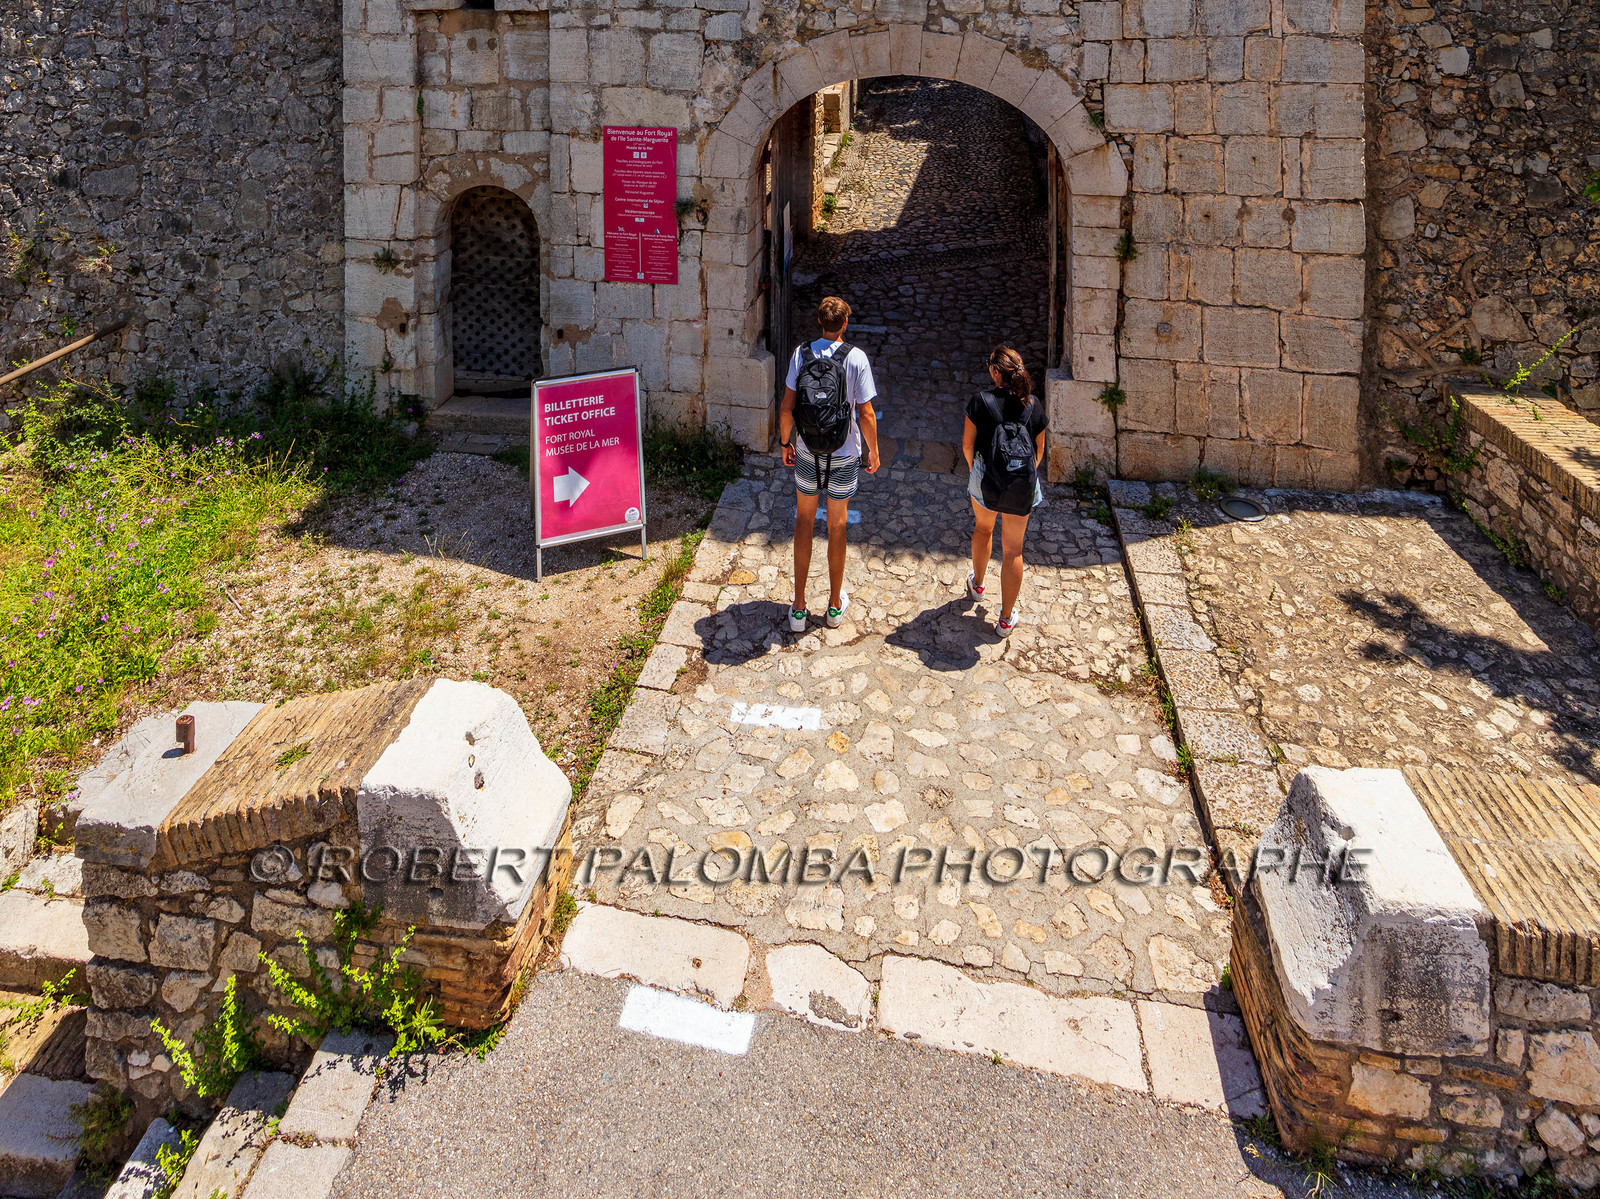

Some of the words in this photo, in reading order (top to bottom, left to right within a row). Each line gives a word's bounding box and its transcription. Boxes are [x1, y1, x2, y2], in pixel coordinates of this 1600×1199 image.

[657, 130, 673, 138] Royal
[544, 395, 604, 413] BILLETTERIE
[544, 412, 579, 427] TICKET
[581, 406, 616, 420] OFFICE
[545, 433, 567, 445] FORT
[569, 429, 596, 441] ROYAL
[545, 443, 575, 457] MUSÉE
[576, 442, 588, 452] DE
[589, 440, 600, 450] LA
[601, 436, 620, 448] MER
